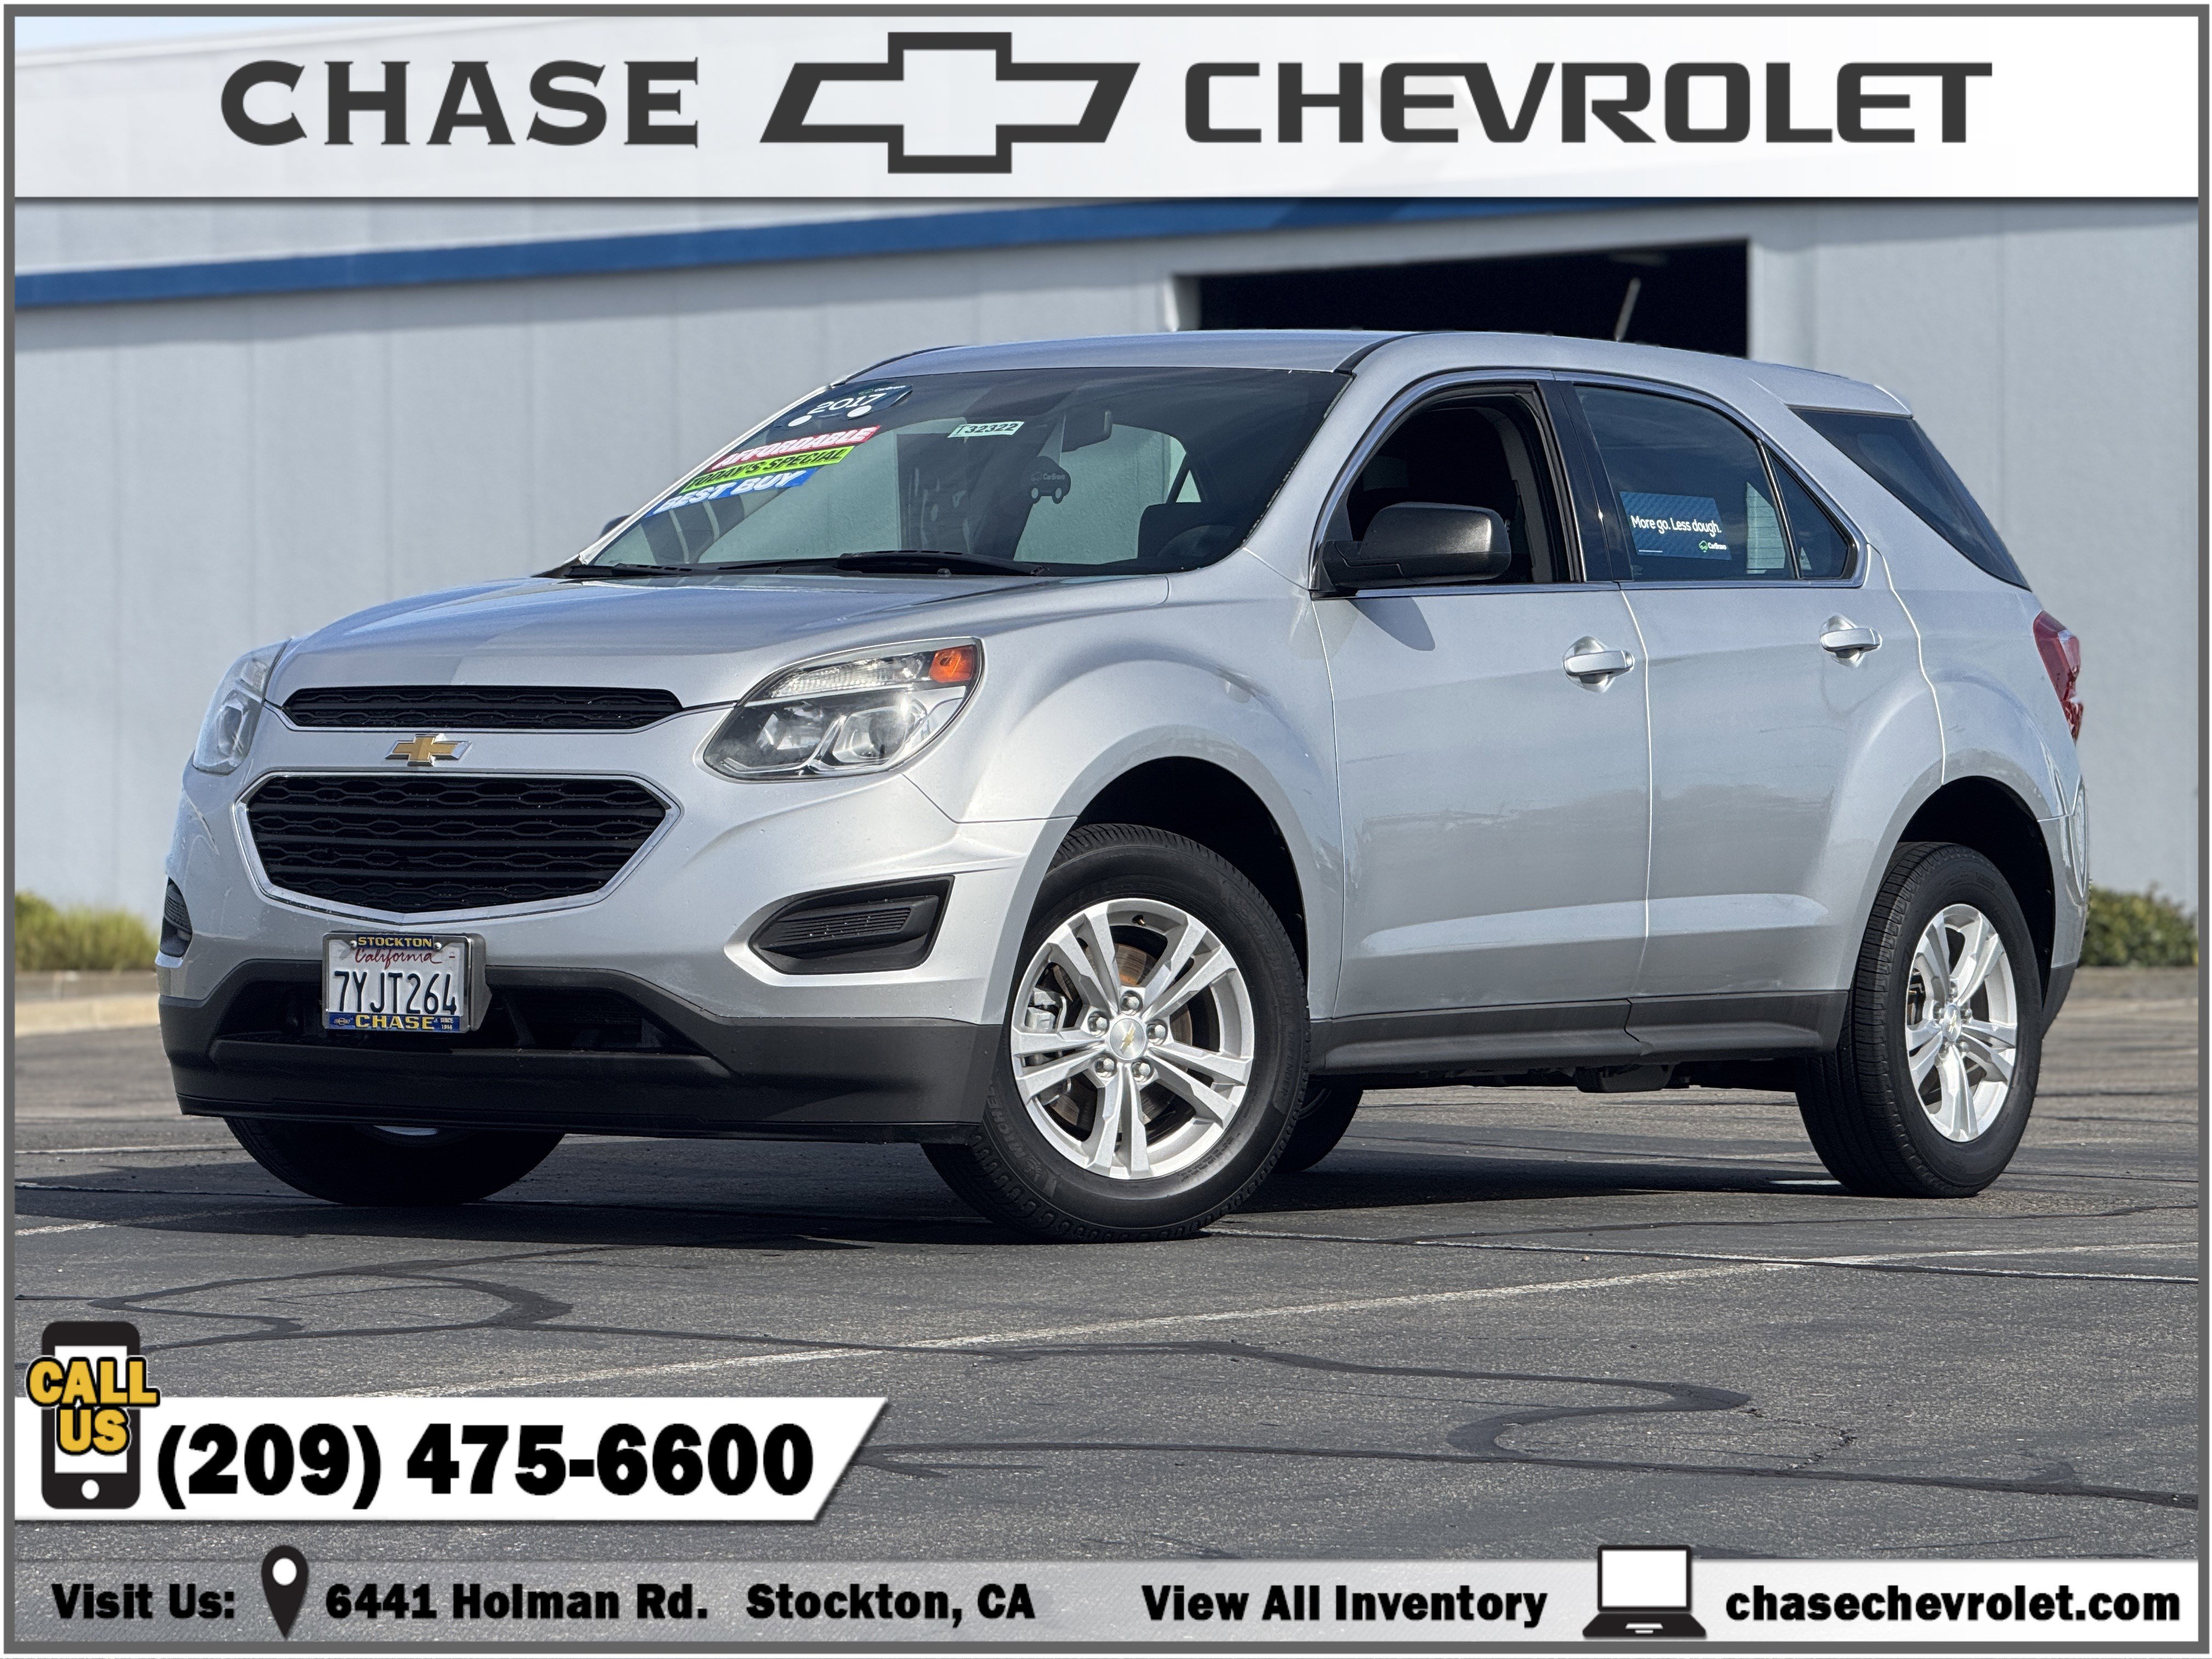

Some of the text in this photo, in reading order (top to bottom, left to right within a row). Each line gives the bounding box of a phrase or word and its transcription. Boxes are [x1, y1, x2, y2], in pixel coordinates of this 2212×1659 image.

[807, 393, 887, 415] 2017
[712, 426, 877, 470] AFFORDABLE
[688, 447, 848, 490] TODAY'S SPECIAL
[653, 470, 809, 514] BEST BUY
[1630, 515, 1722, 538] More go. Less dough.
[358, 936, 432, 947] STOCKTON
[355, 948, 442, 970] California
[334, 970, 457, 1015] 7YJT264
[355, 1014, 435, 1030] CHASE
